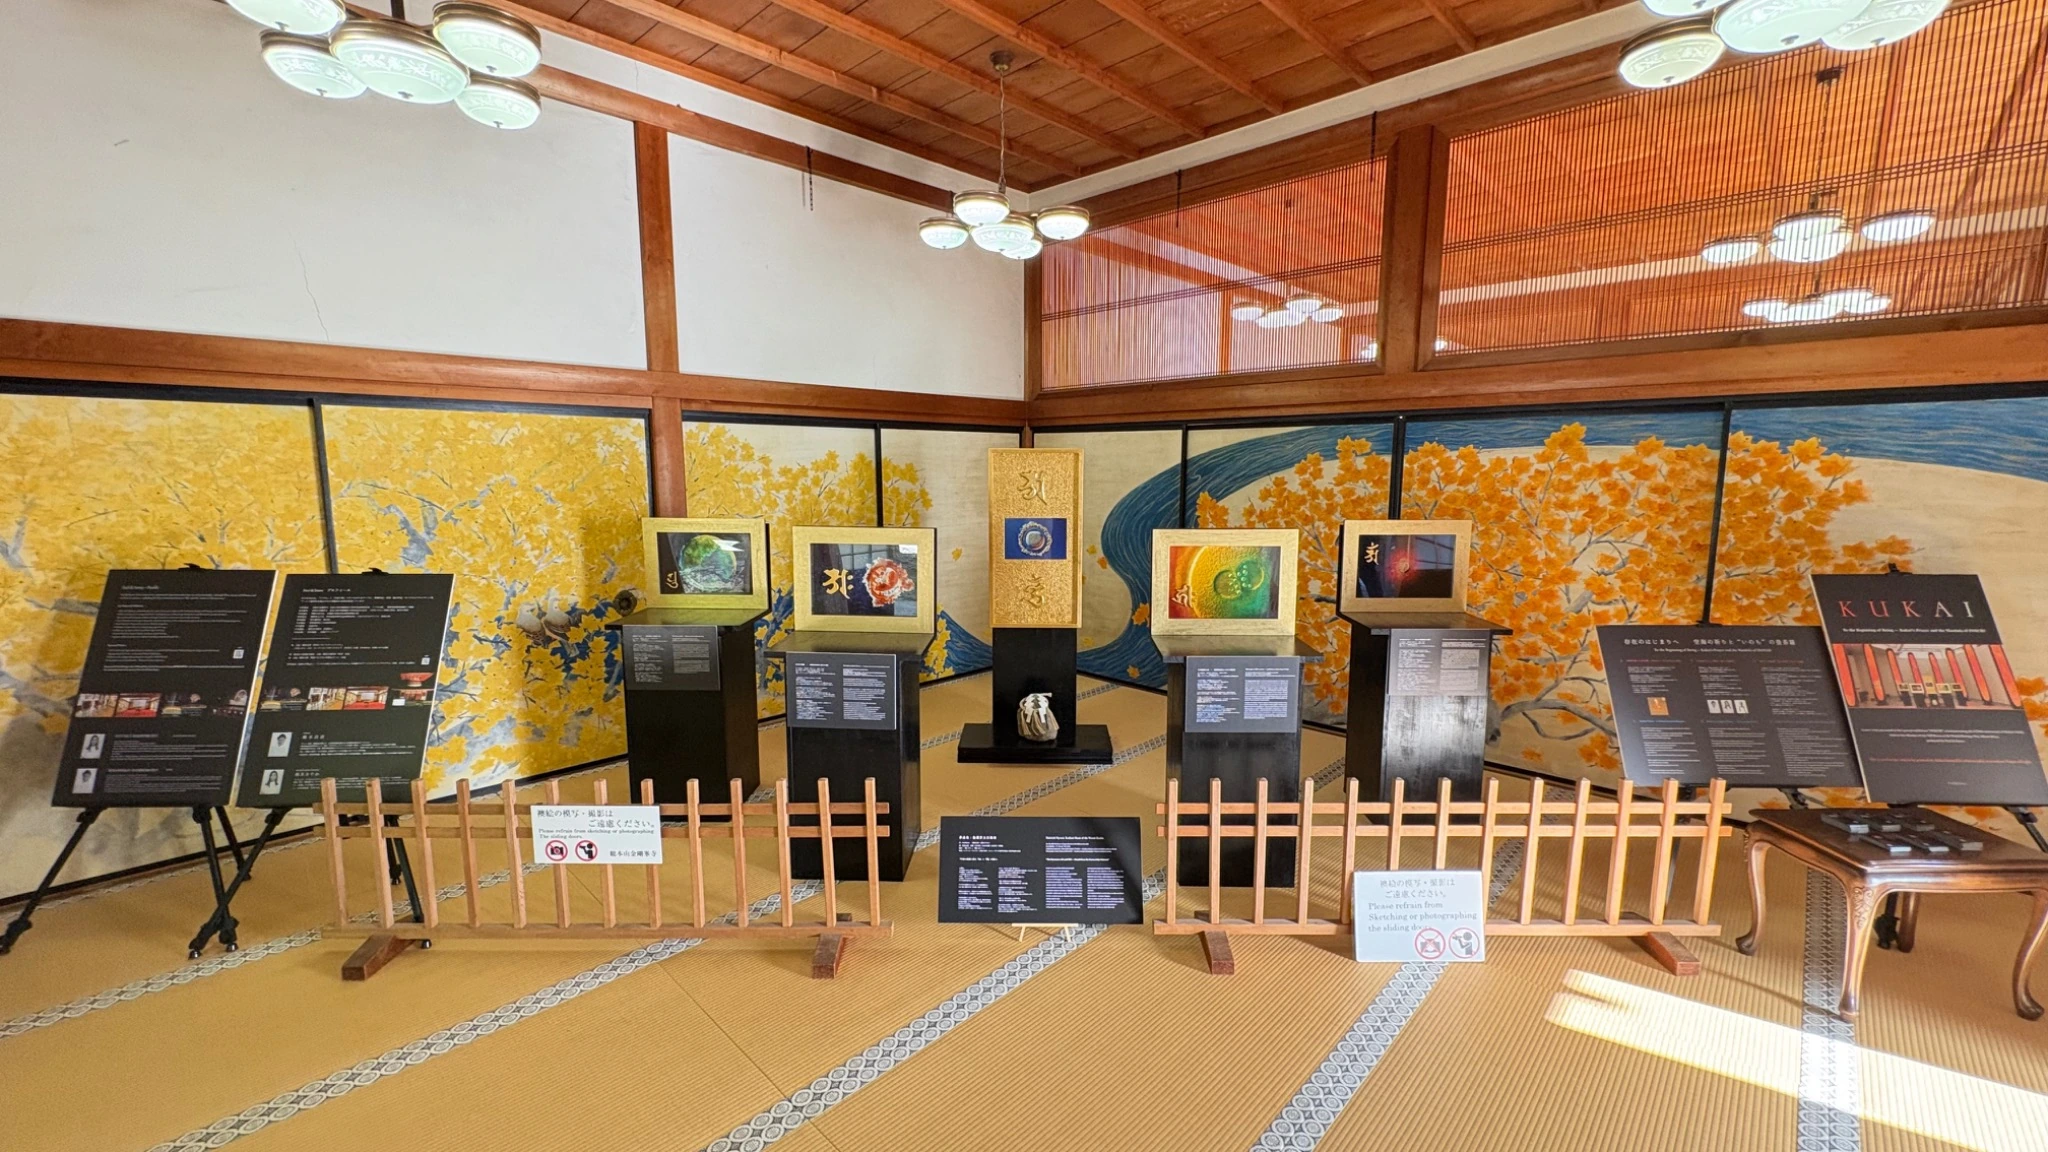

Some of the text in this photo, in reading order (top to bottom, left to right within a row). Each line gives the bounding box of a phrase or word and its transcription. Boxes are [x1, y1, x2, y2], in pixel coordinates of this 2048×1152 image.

[1838, 600, 1974, 618] KUKAI
[589, 819, 654, 828] ご遠慮ください。
[1369, 913, 1407, 921] Sketching
[1420, 912, 1477, 921] photographing
